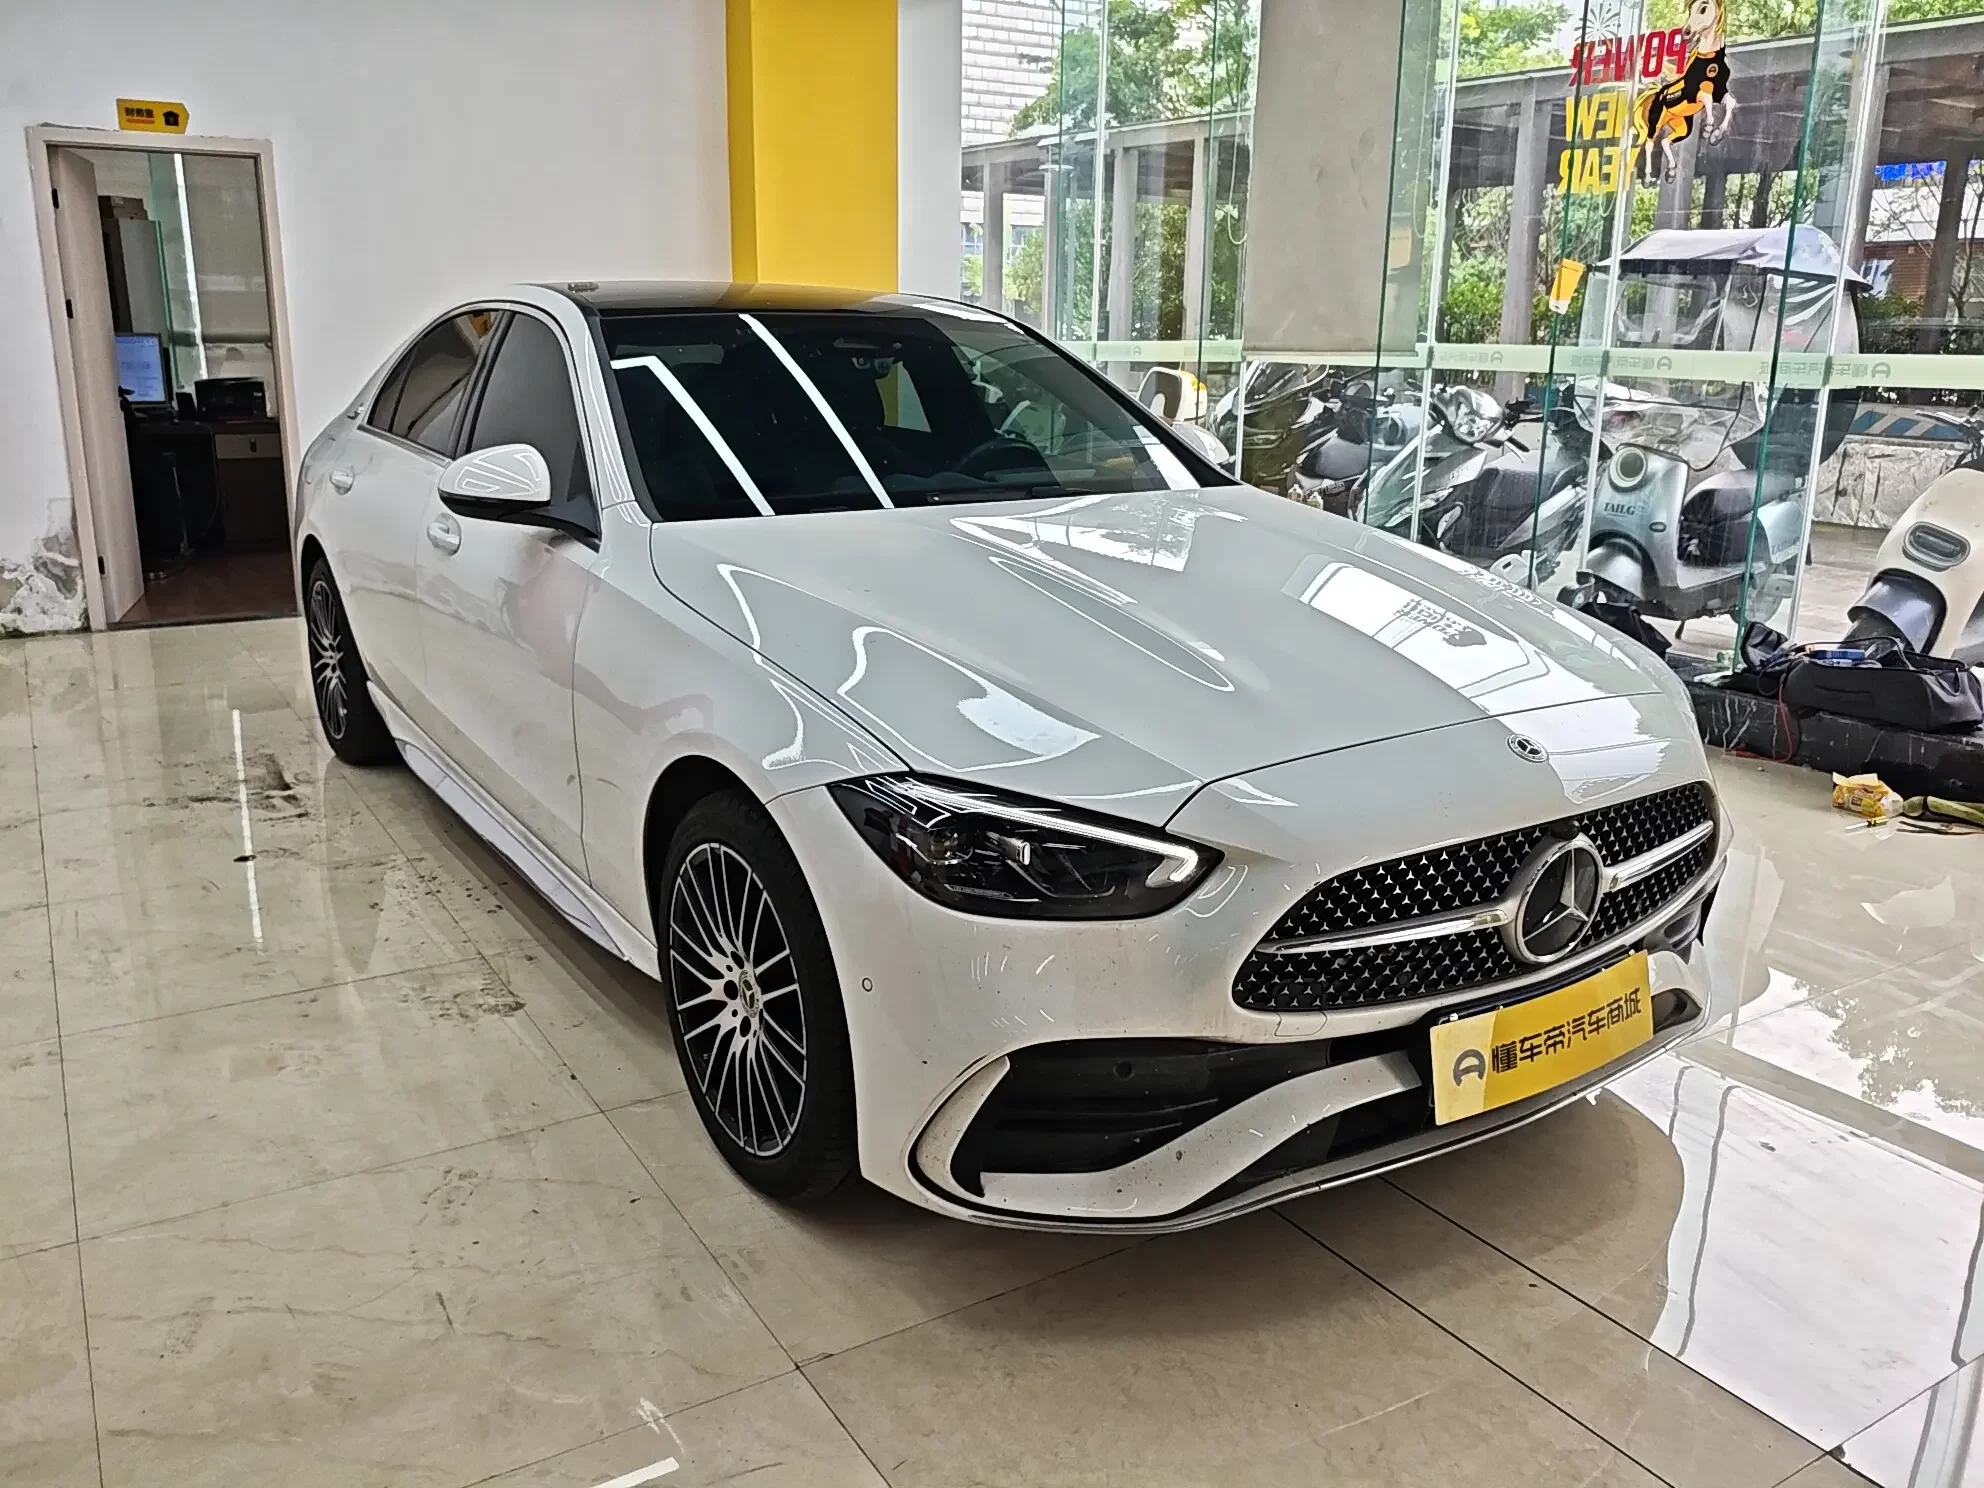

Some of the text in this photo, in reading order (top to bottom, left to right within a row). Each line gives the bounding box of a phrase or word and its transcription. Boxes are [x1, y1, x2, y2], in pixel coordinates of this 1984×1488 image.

[1491, 988, 1641, 1074] 懂车帝汽车商城
